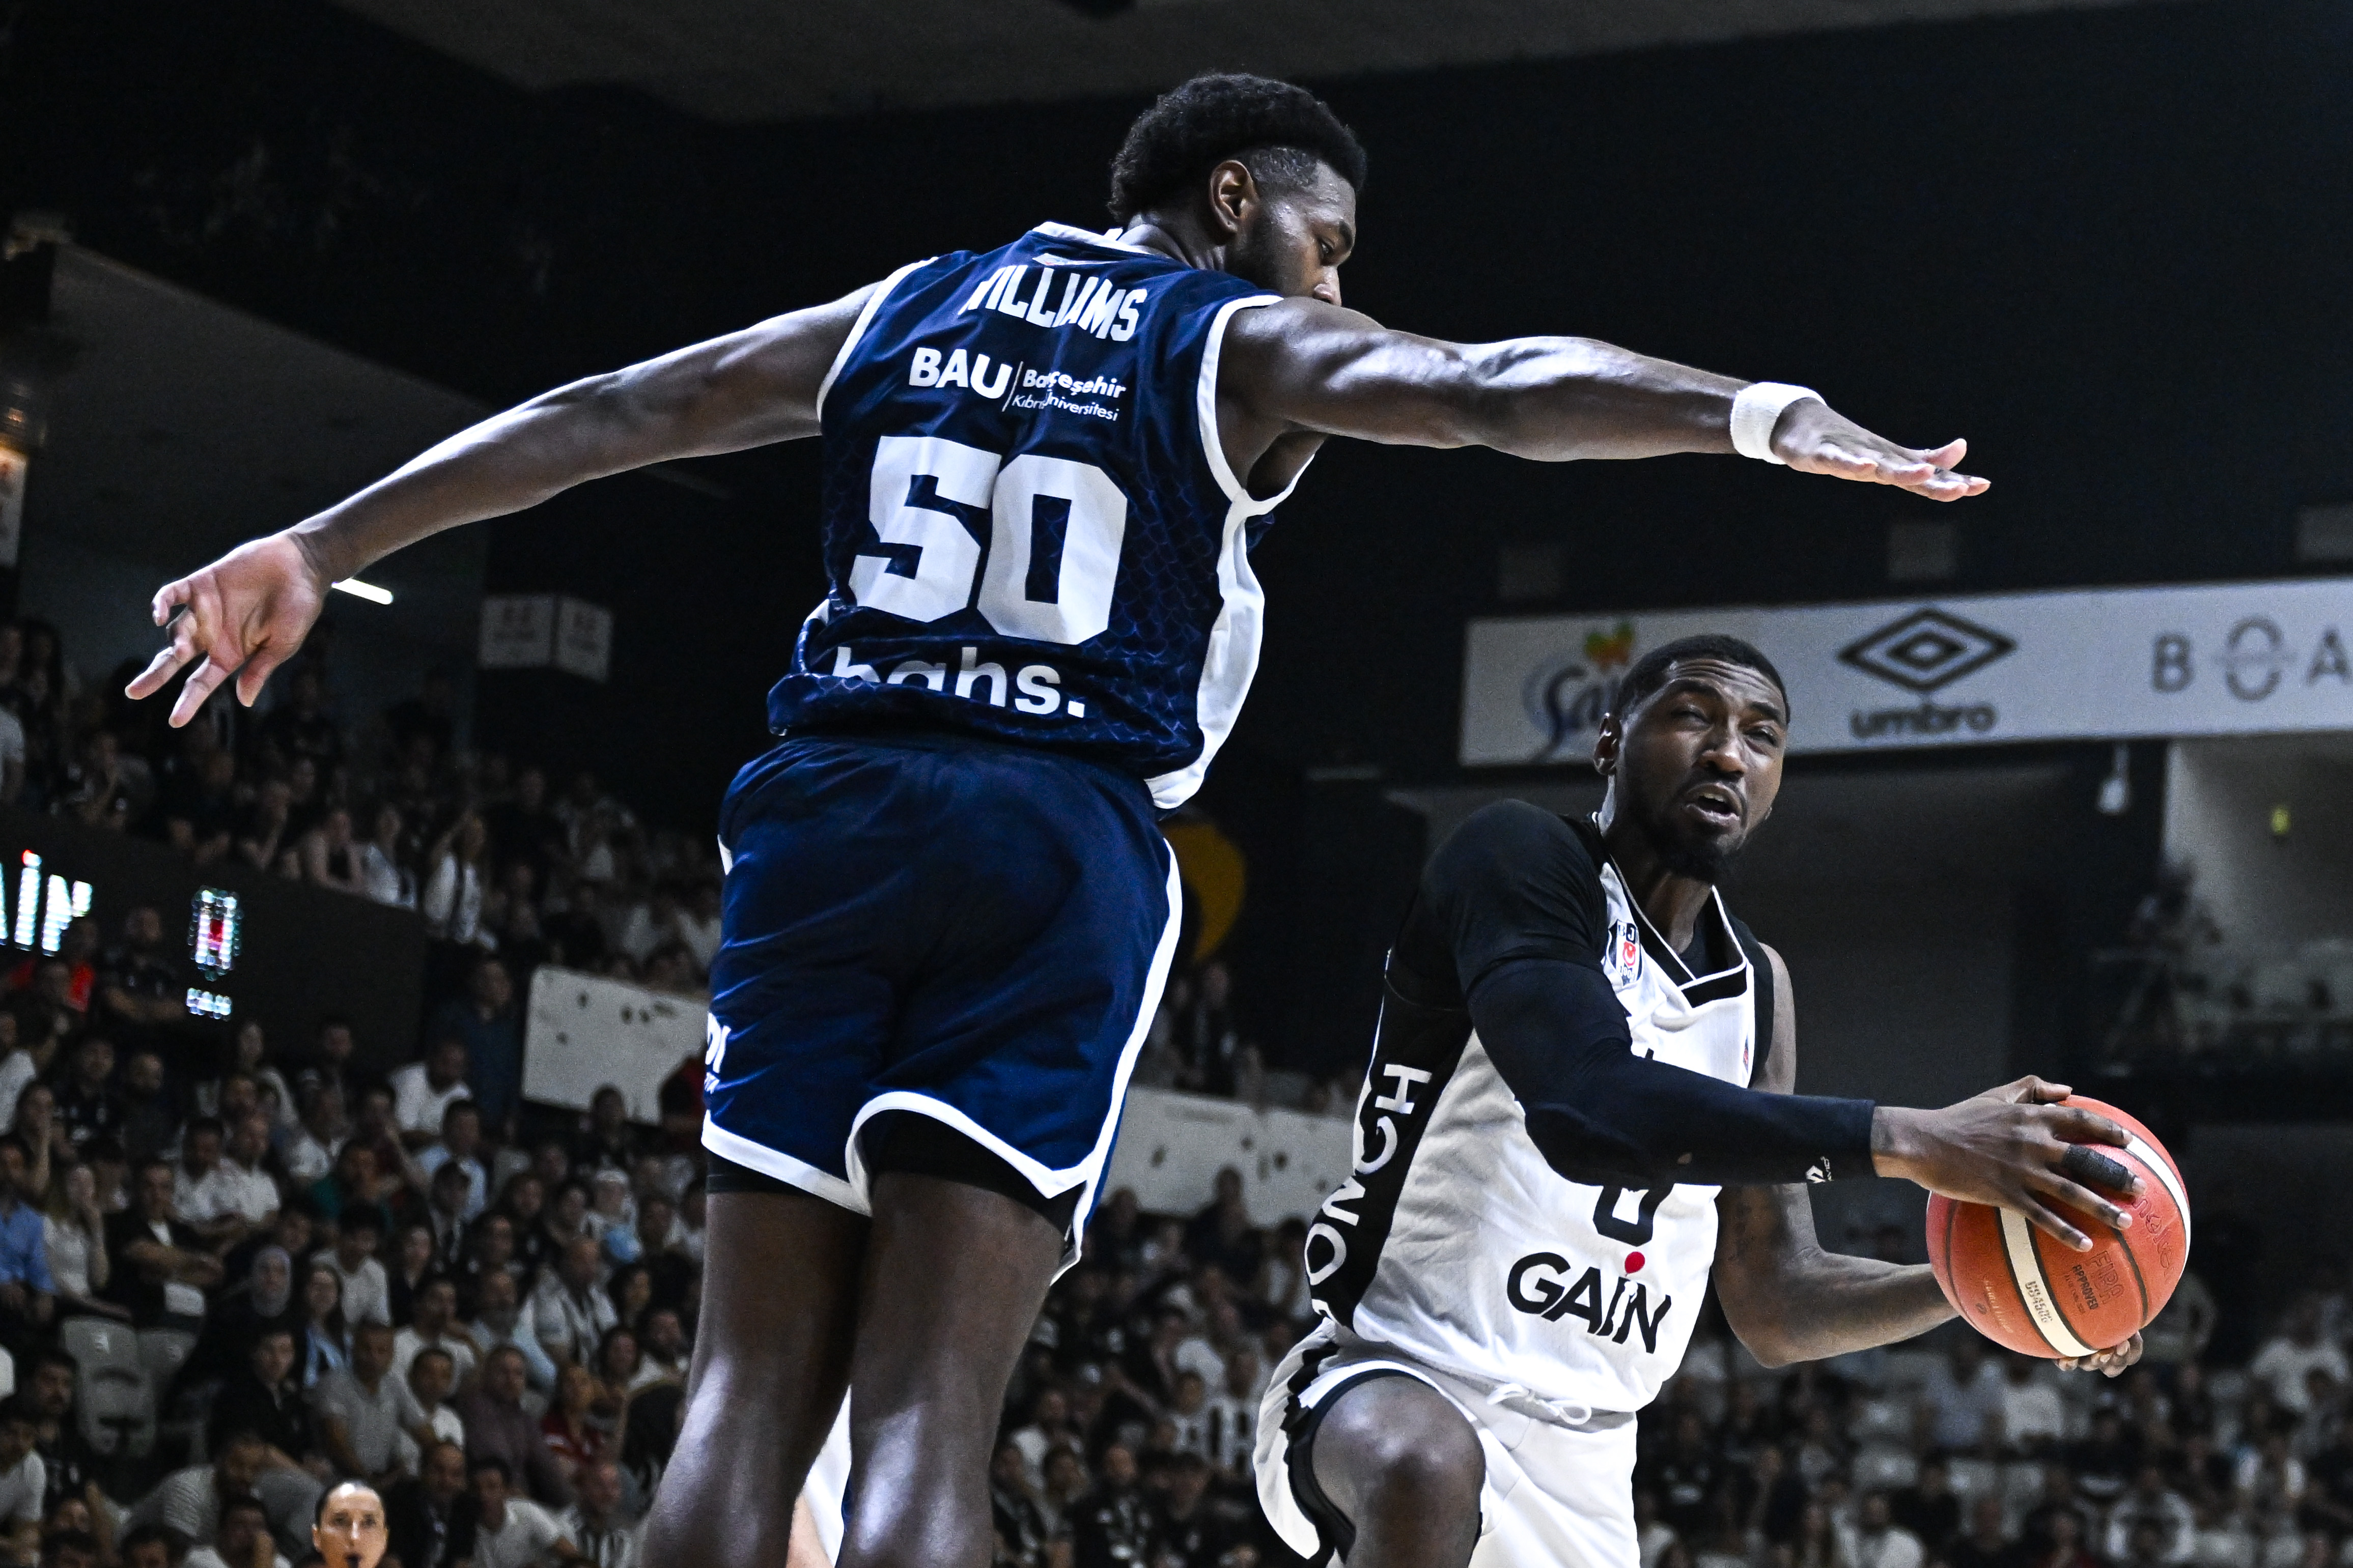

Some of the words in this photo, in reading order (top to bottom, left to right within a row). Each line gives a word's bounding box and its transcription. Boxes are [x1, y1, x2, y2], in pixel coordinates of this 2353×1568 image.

[909, 347, 1012, 400] BAU
[1022, 369, 1127, 398] Baçeşehir
[849, 435, 1128, 645] 50
[1849, 701, 1998, 738] umbro
[1507, 1252, 1671, 1354] GAIN
[2072, 1264, 2098, 1310] APPROVED
[2086, 1250, 2124, 1305] FIBA
